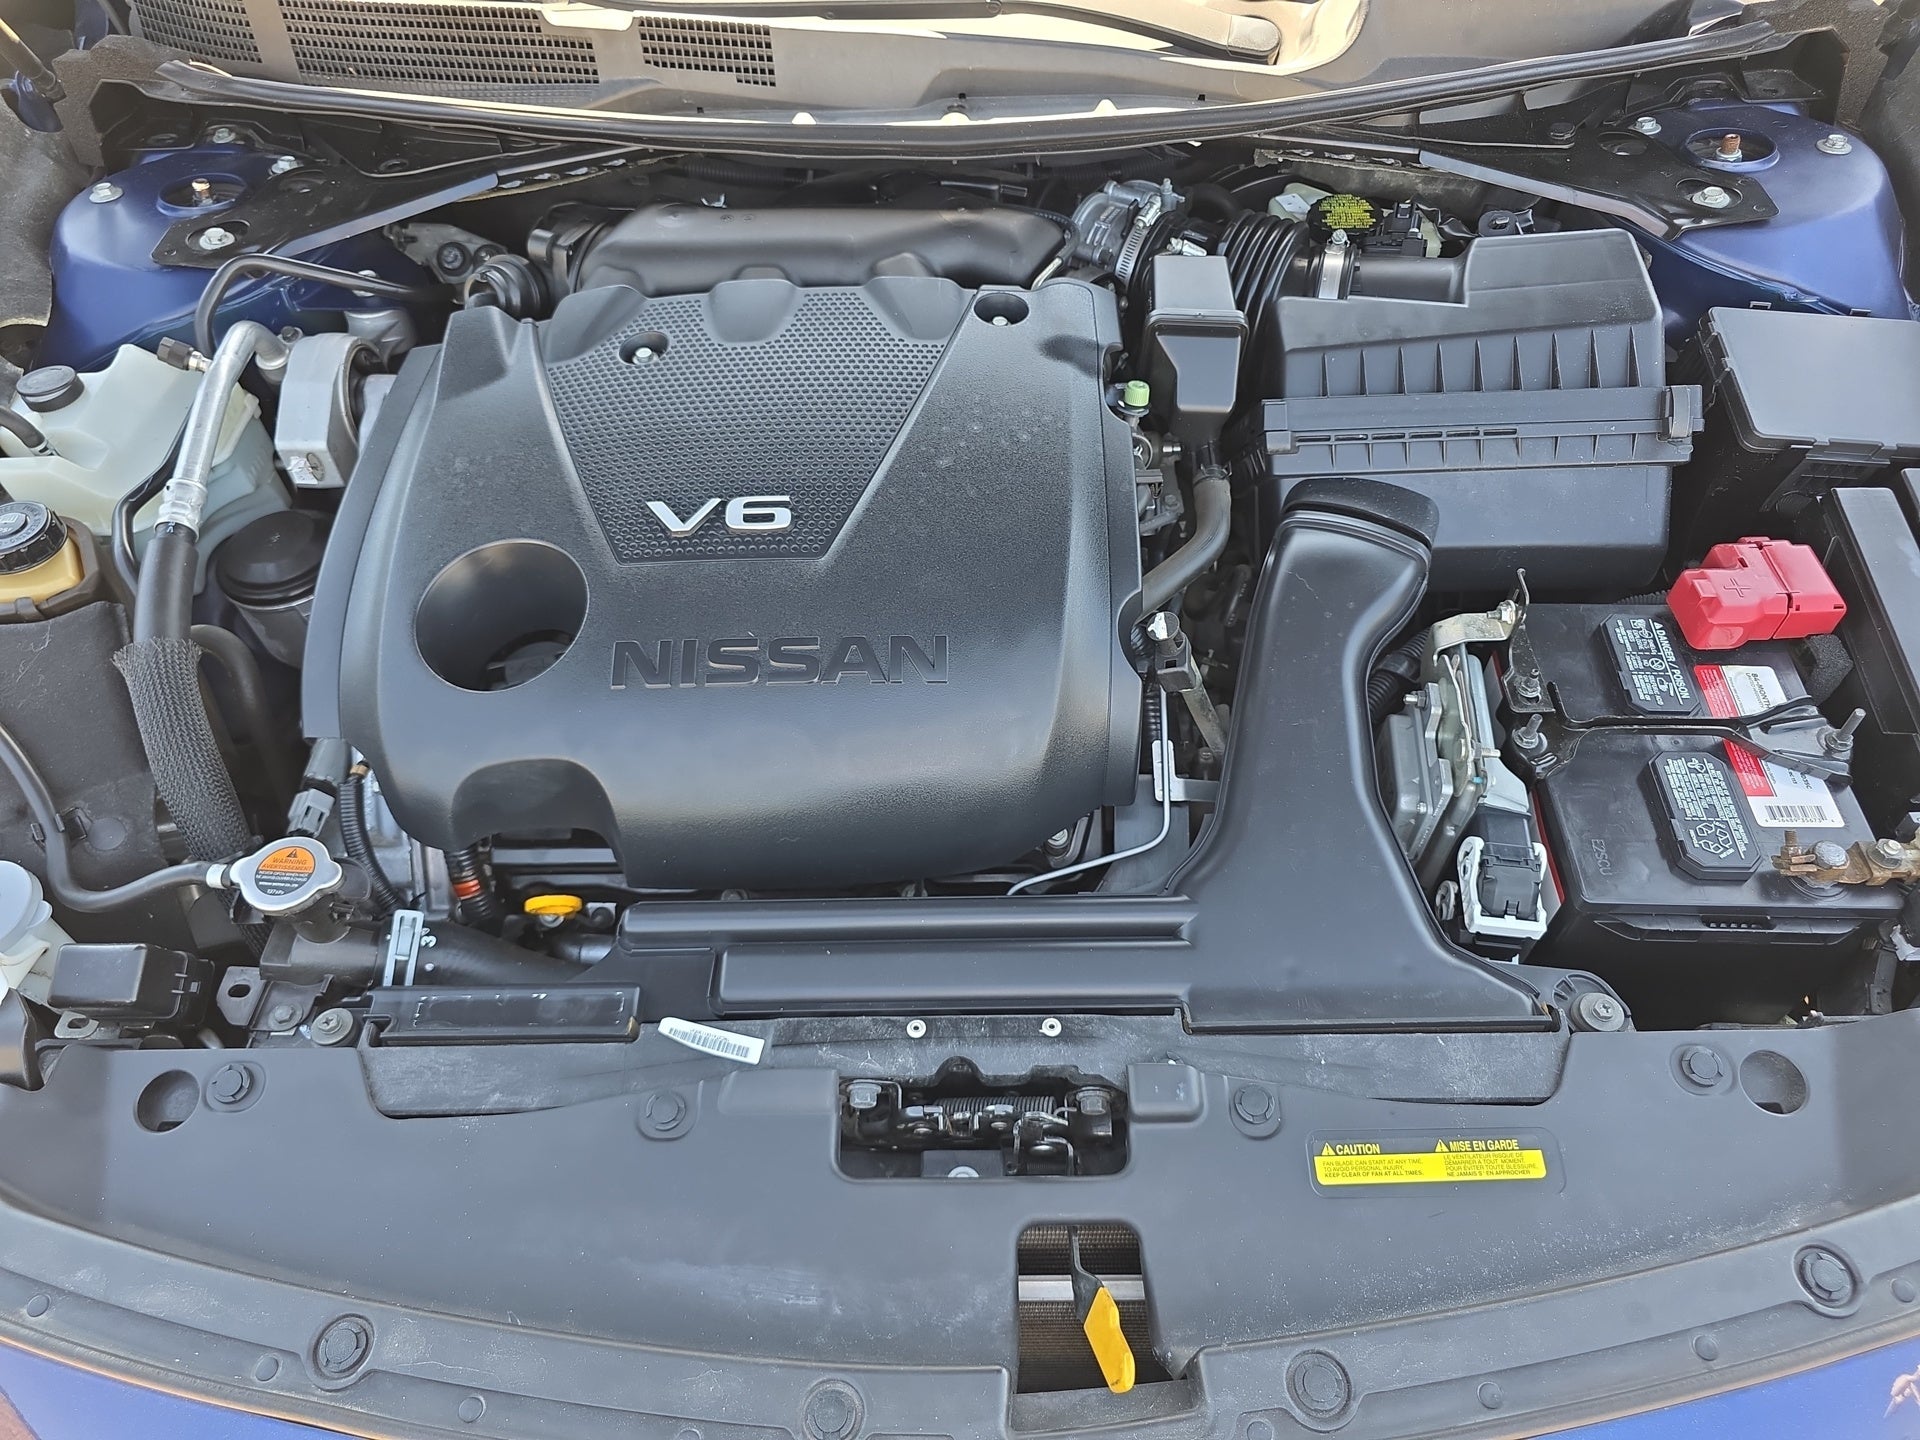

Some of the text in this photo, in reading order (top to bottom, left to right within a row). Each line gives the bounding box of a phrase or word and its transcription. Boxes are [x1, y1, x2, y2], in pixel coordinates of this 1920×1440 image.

[646, 495, 793, 537] V6
[611, 635, 948, 690] NISSAN
[1657, 630, 1676, 661] DANGER
[1671, 669, 1690, 699] POISON
[273, 857, 307, 865] WARNING
[1336, 1143, 1381, 1155] CAUTION
[1449, 1139, 1519, 1152] MISE EN GARDE
